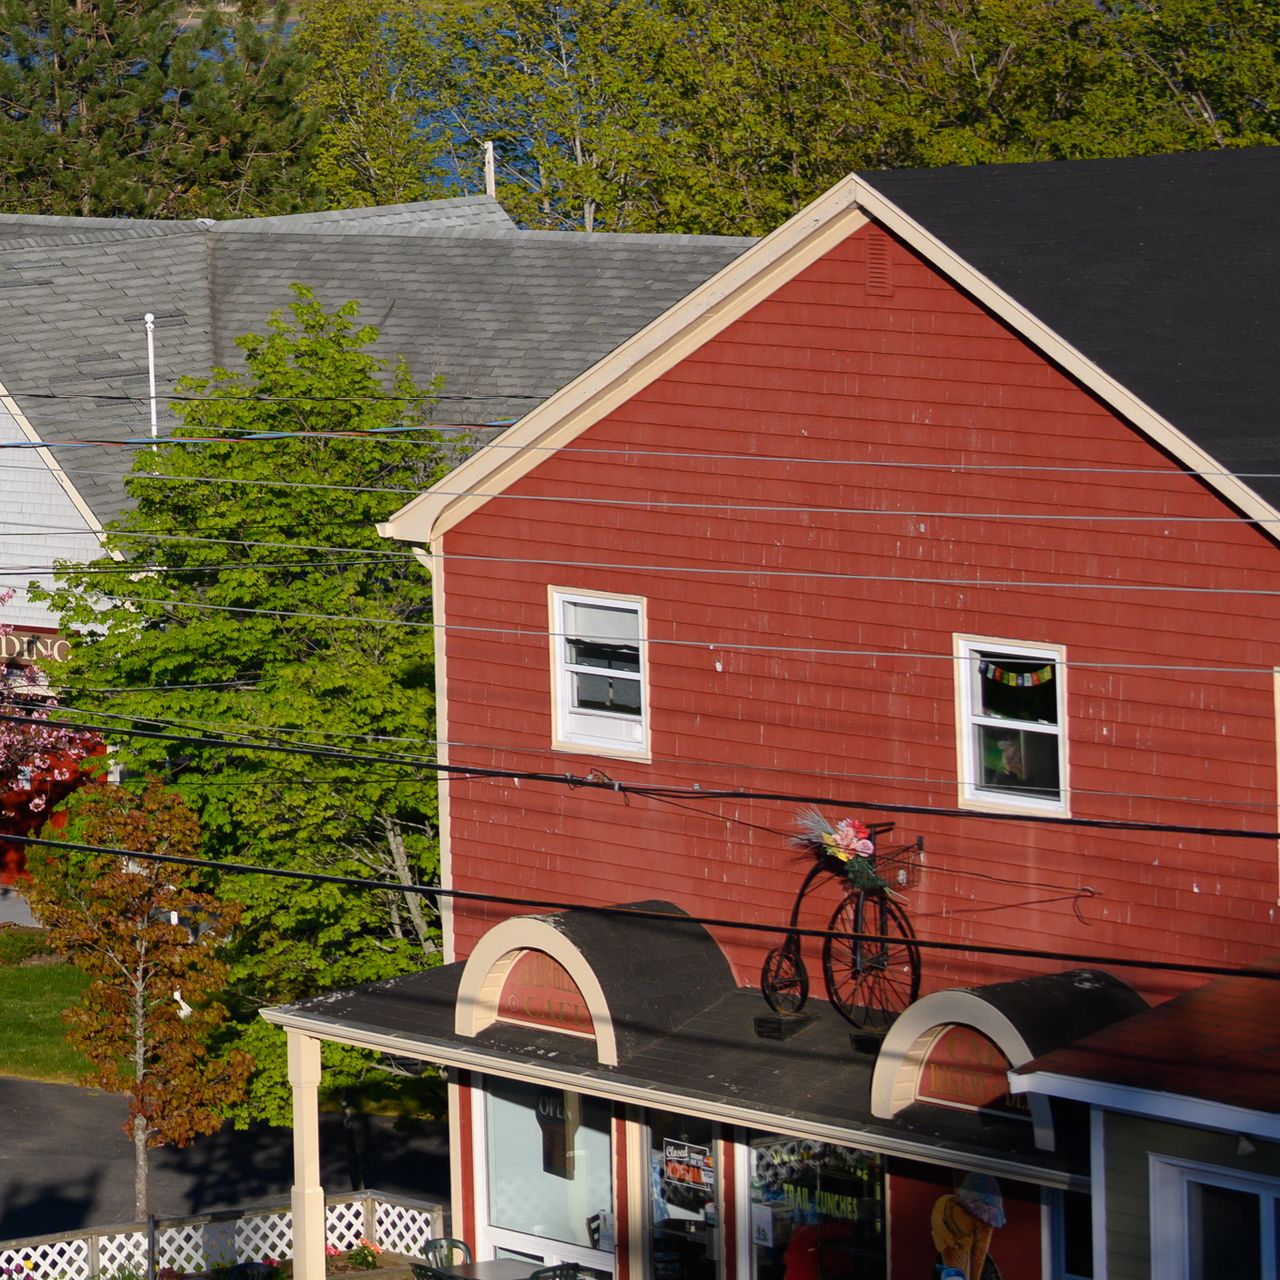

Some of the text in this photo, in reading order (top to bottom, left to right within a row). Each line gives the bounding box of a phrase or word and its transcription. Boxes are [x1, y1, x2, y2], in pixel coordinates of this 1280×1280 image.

[525, 993, 589, 1027] CAFE
[946, 1033, 1004, 1069] CAF
[666, 1145, 688, 1158] Closed
[783, 1182, 859, 1221] TRAIL LUNCHES
